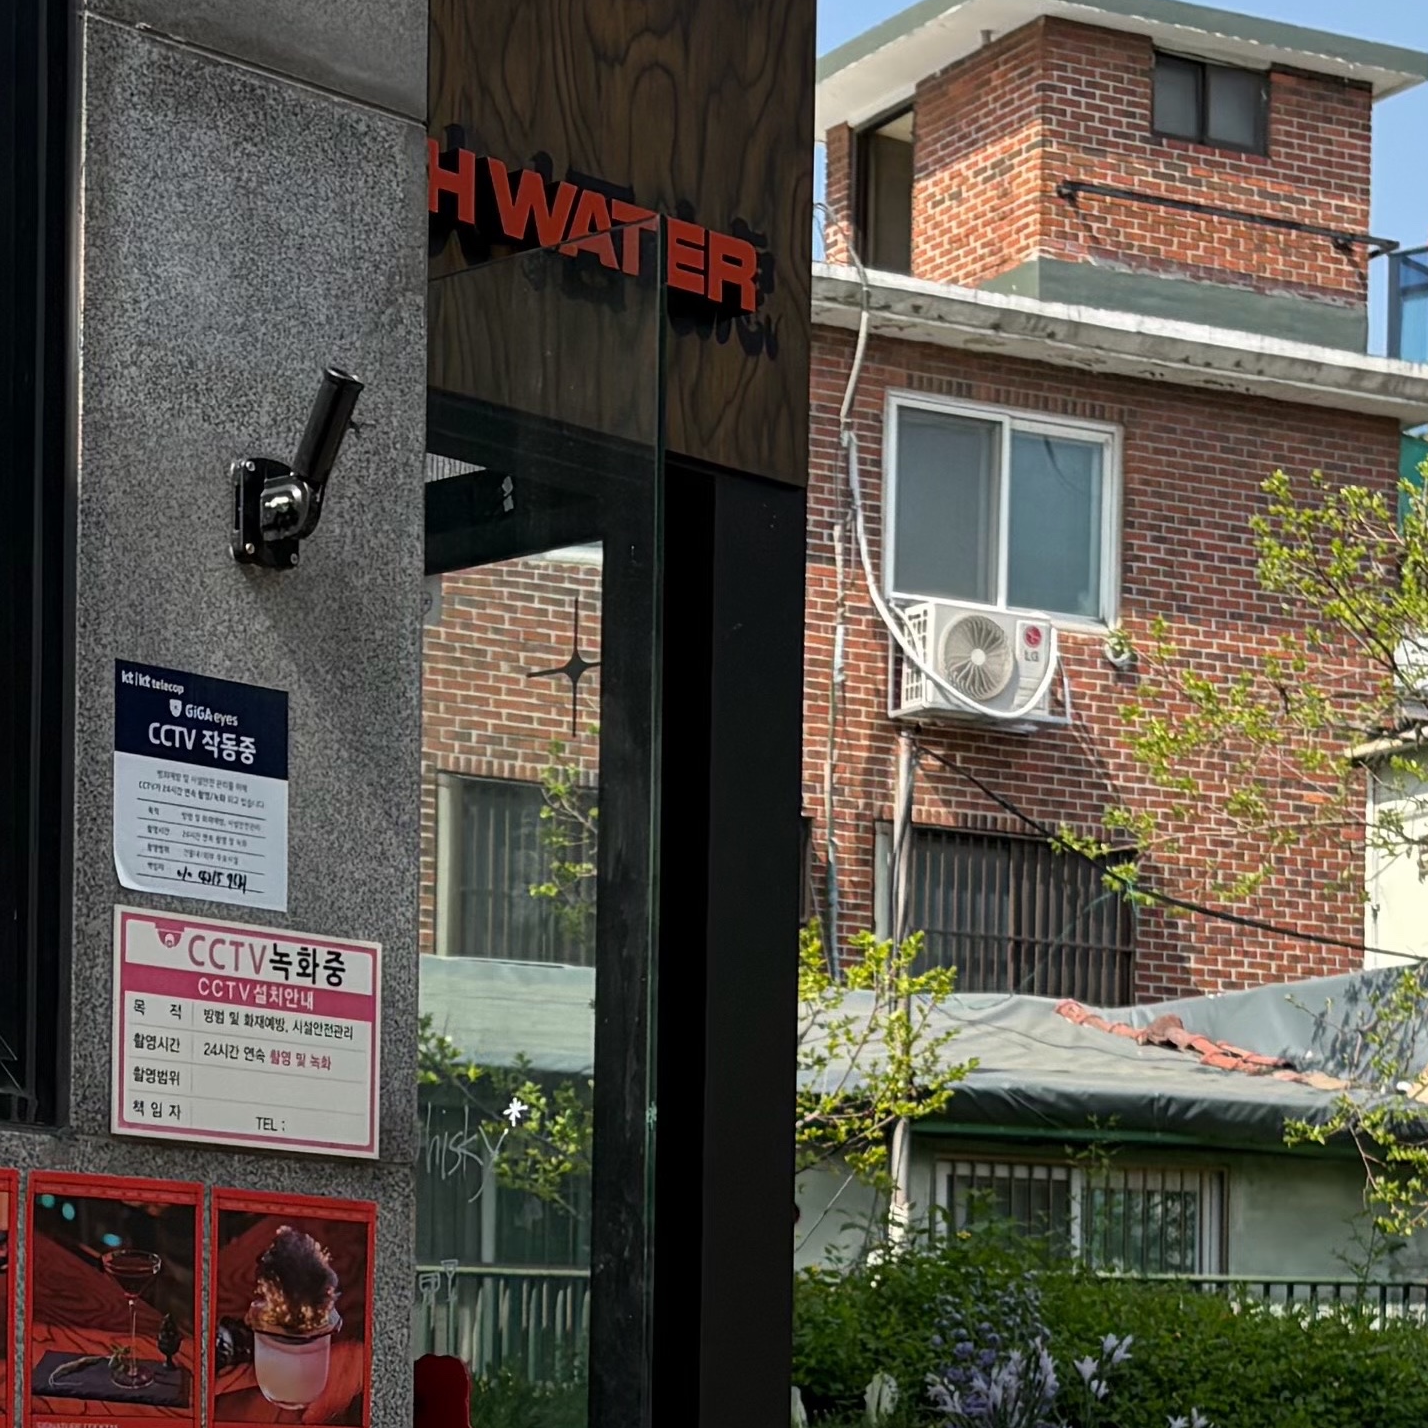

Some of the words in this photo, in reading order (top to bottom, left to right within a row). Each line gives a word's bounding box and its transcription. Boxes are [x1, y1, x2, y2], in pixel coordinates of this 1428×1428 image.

[1024, 650, 1039, 662] LG
[148, 722, 196, 751] CCTV
[201, 730, 257, 765] 작동중
[229, 1011, 239, 1026] 및
[292, 1017, 354, 1041] 시설안전관리
[133, 1033, 180, 1053] 촬영시간
[204, 1042, 239, 1061] 24시간
[244, 1046, 266, 1063] 연속
[133, 1066, 180, 1086] 촬영범위
[256, 1117, 277, 1132] TEL
